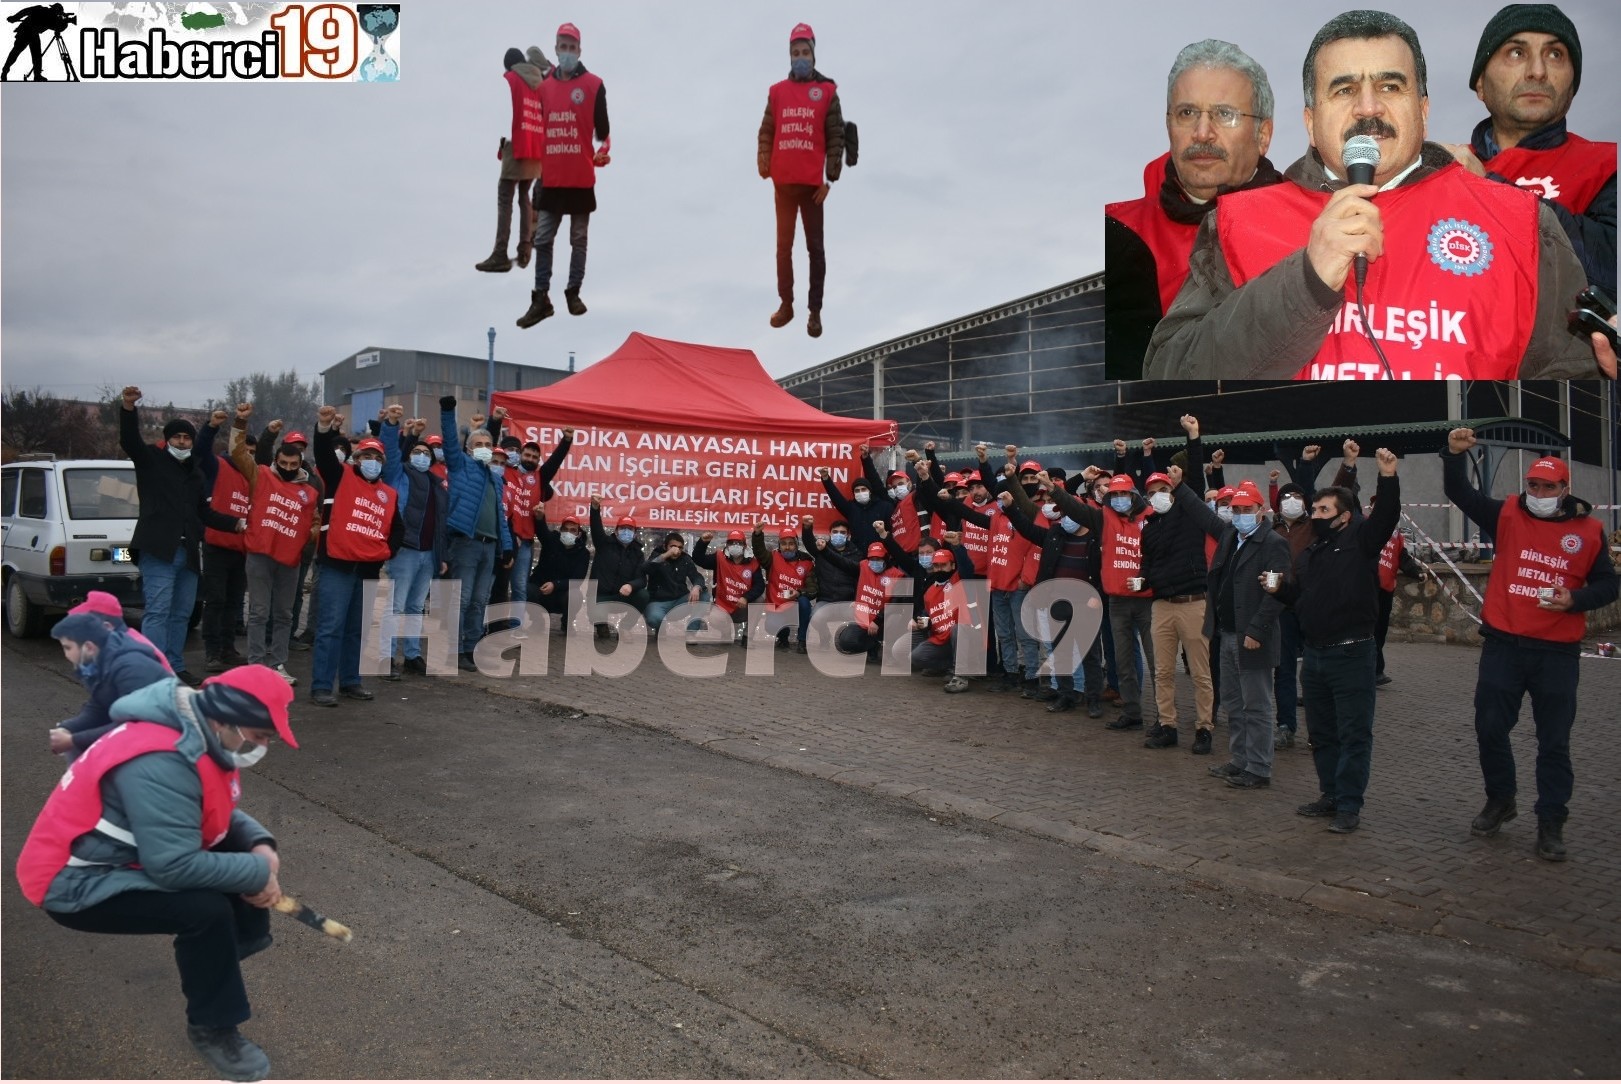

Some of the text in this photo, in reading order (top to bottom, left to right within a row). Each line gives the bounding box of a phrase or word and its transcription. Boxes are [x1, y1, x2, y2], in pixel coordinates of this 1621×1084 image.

[1448, 240, 1471, 252] DİSK
[636, 433, 763, 456] ANAYASAL
[769, 441, 853, 460] HAKTIR
[619, 453, 699, 478] İŞÇİLER
[705, 459, 757, 479] GERİ
[269, 492, 303, 512] BİRLEŞİK
[354, 496, 385, 516] BİRLEŞİK
[549, 480, 837, 510] KMEKÇİOĞULLARI İŞÇİLER
[266, 506, 299, 526] METAL-İŞ
[575, 503, 614, 519] DK
[650, 506, 720, 524] BİRLEŞİK
[724, 511, 800, 528] METAL-İŞ
[1520, 548, 1569, 570] BİRLEŞİK
